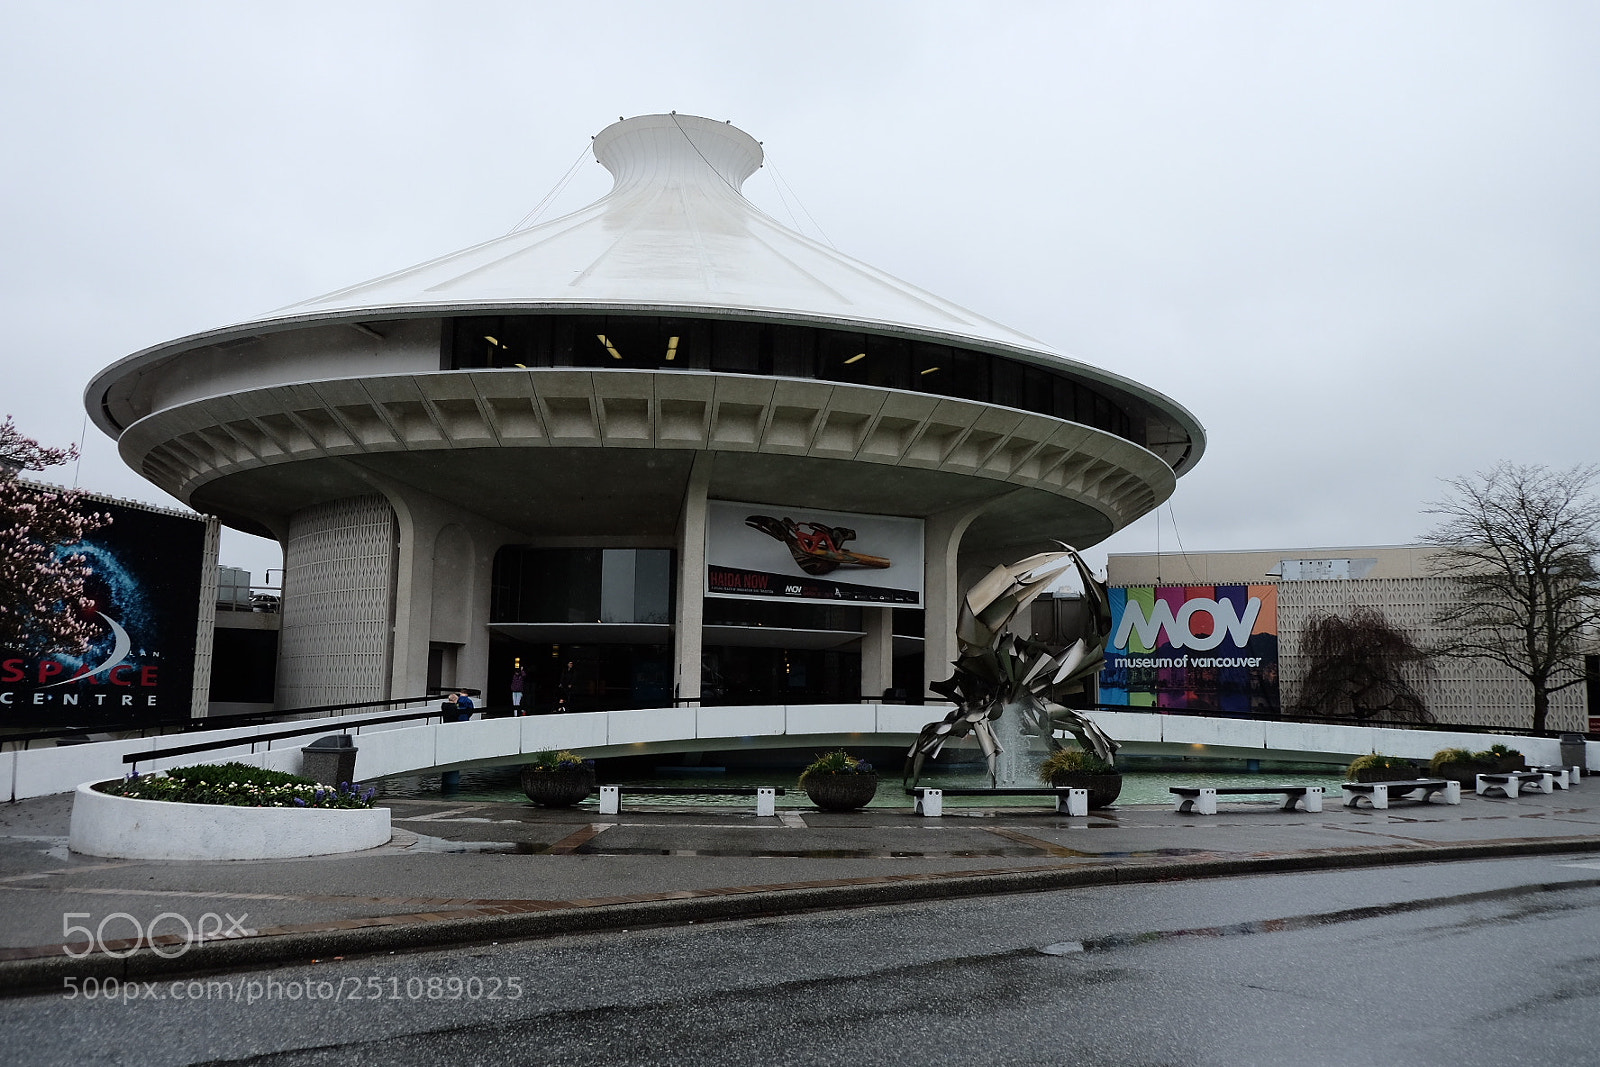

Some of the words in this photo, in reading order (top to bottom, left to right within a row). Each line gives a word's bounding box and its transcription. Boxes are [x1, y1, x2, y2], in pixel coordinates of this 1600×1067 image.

[710, 571, 741, 588] HAIDA
[744, 574, 769, 589] NOW
[1114, 597, 1261, 651] MOV
[1115, 657, 1172, 668] museum
[1174, 655, 1188, 668] of
[1191, 657, 1262, 668] vancouver
[1, 659, 159, 687] SPACE
[0, 692, 157, 706] CENTRE
